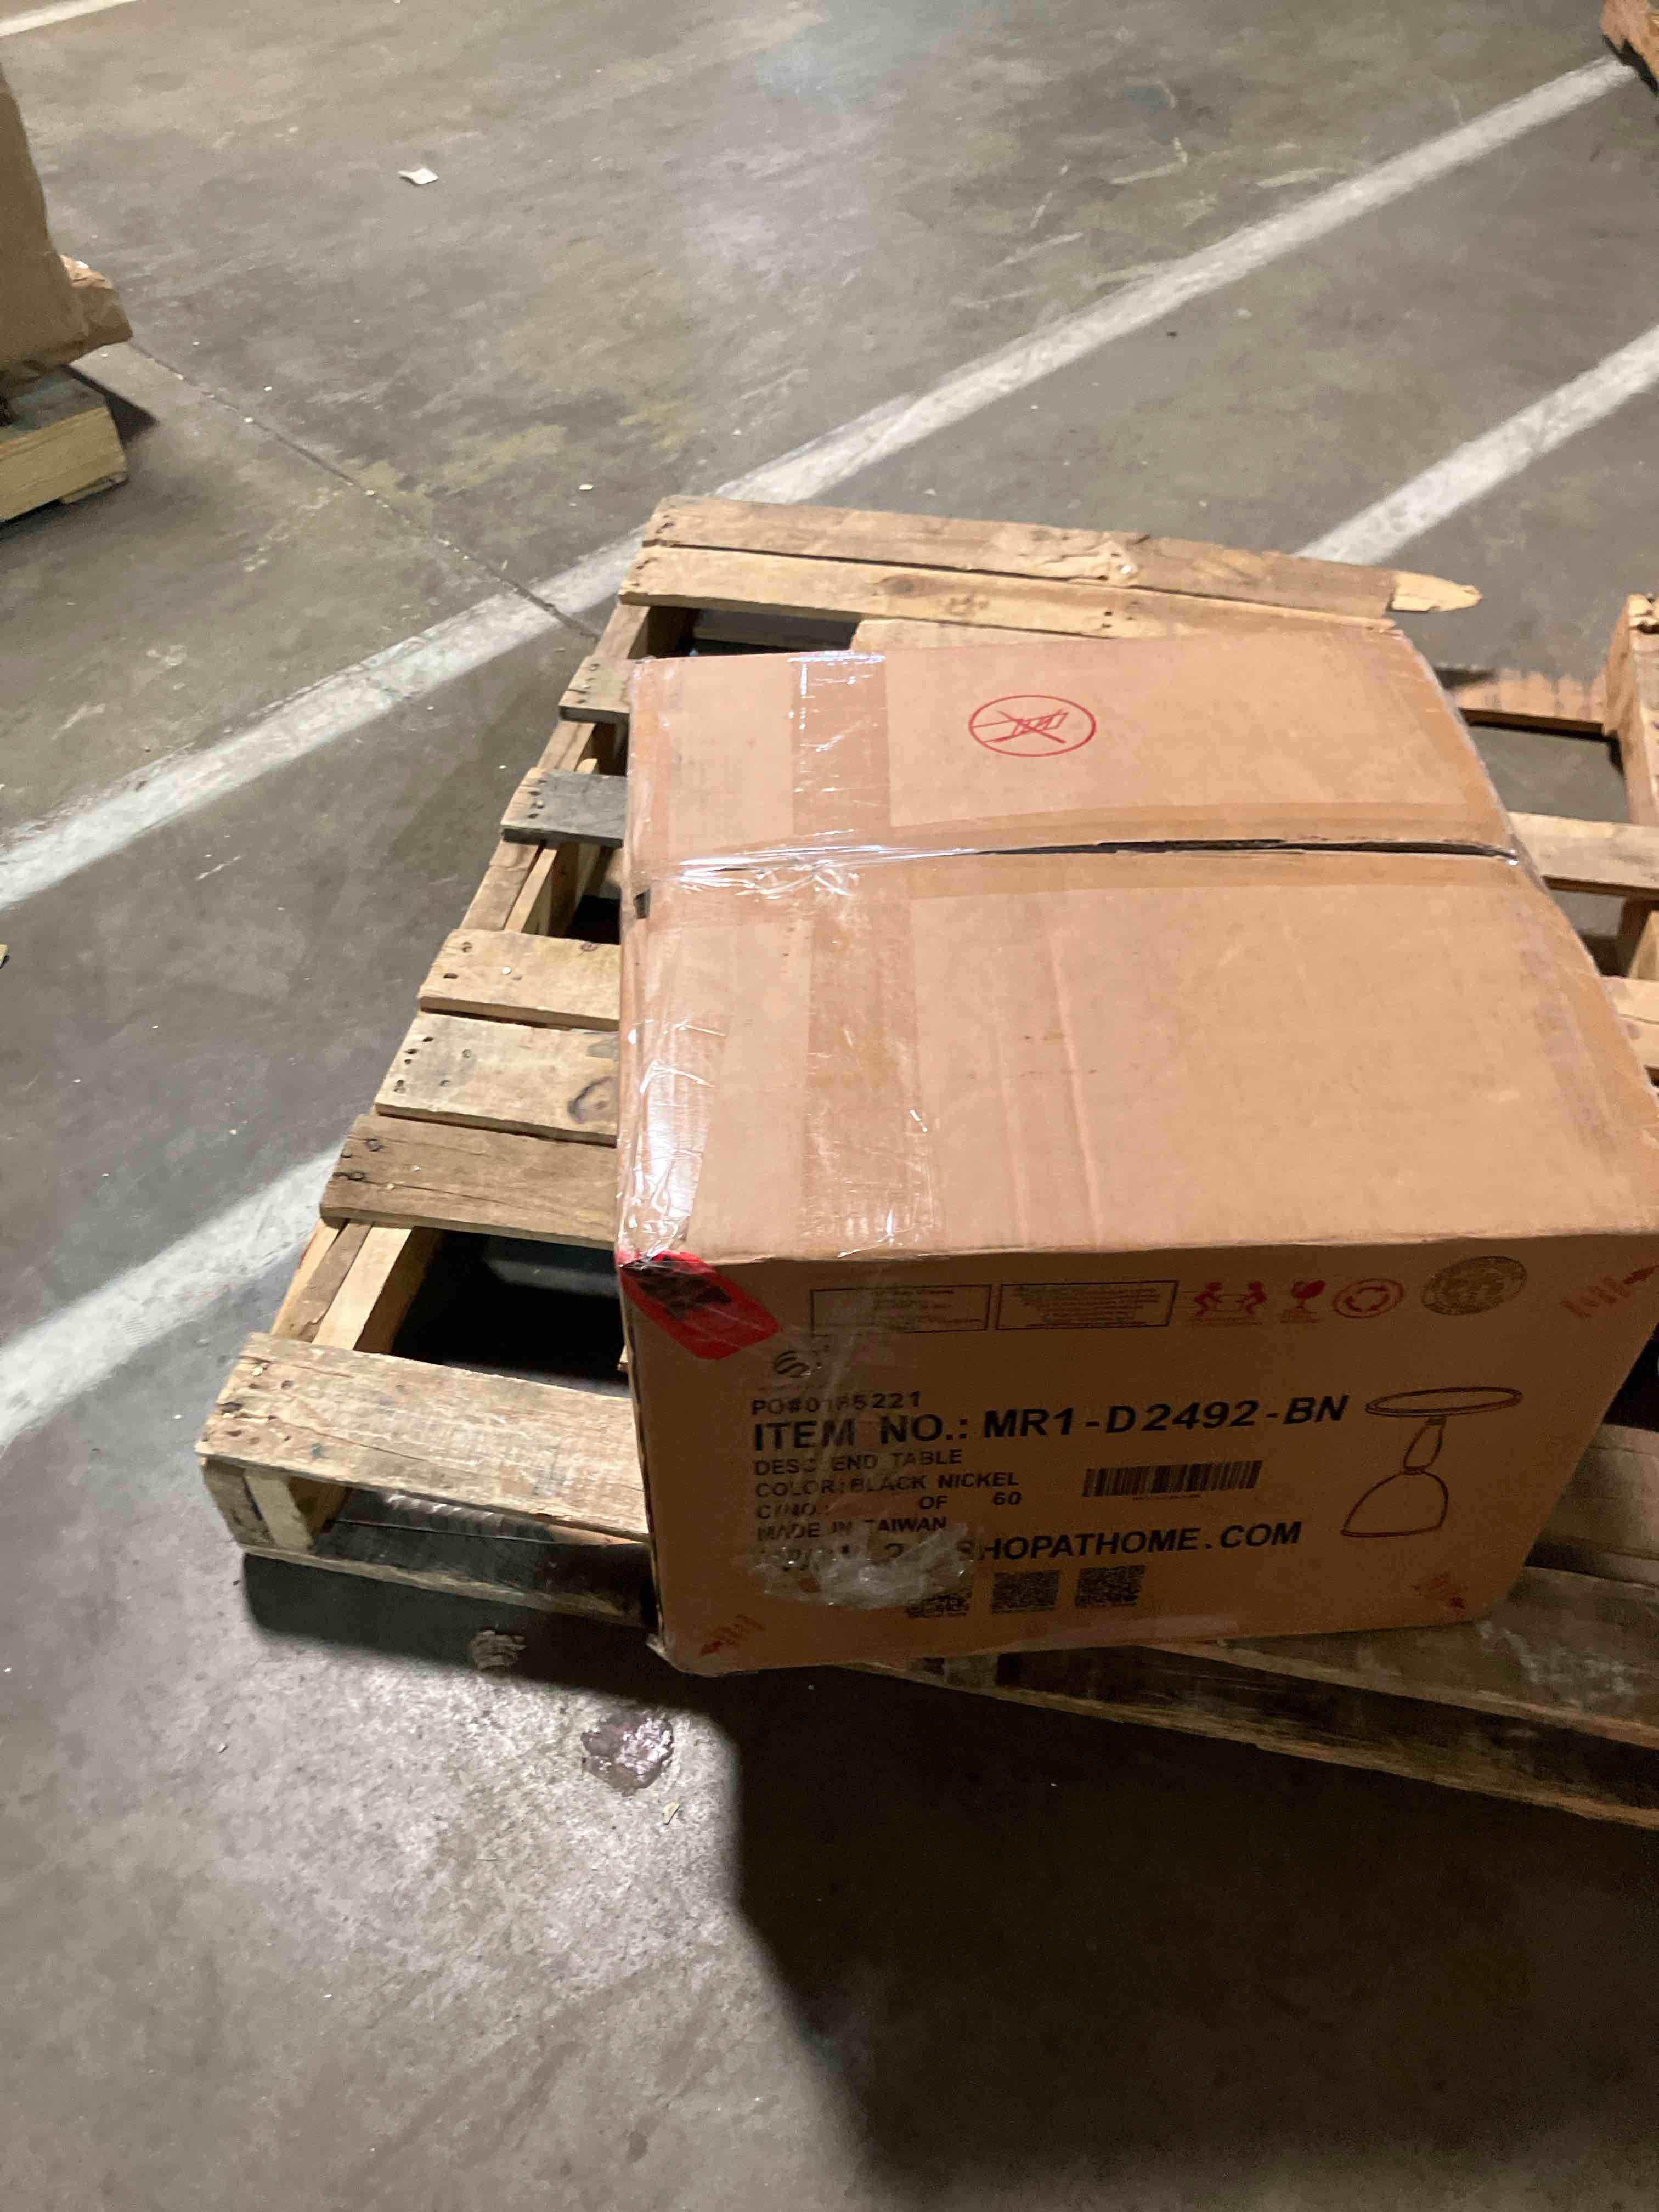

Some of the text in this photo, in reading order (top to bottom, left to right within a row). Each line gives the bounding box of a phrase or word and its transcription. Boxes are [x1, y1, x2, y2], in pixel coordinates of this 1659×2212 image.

[754, 1418, 856, 1451] ITEM
[880, 1413, 968, 1444] NO.:
[891, 1448, 963, 1467] TABLE
[938, 1471, 1020, 1489] NICKEL
[919, 1494, 949, 1510] OF
[992, 1491, 1022, 1506] 60
